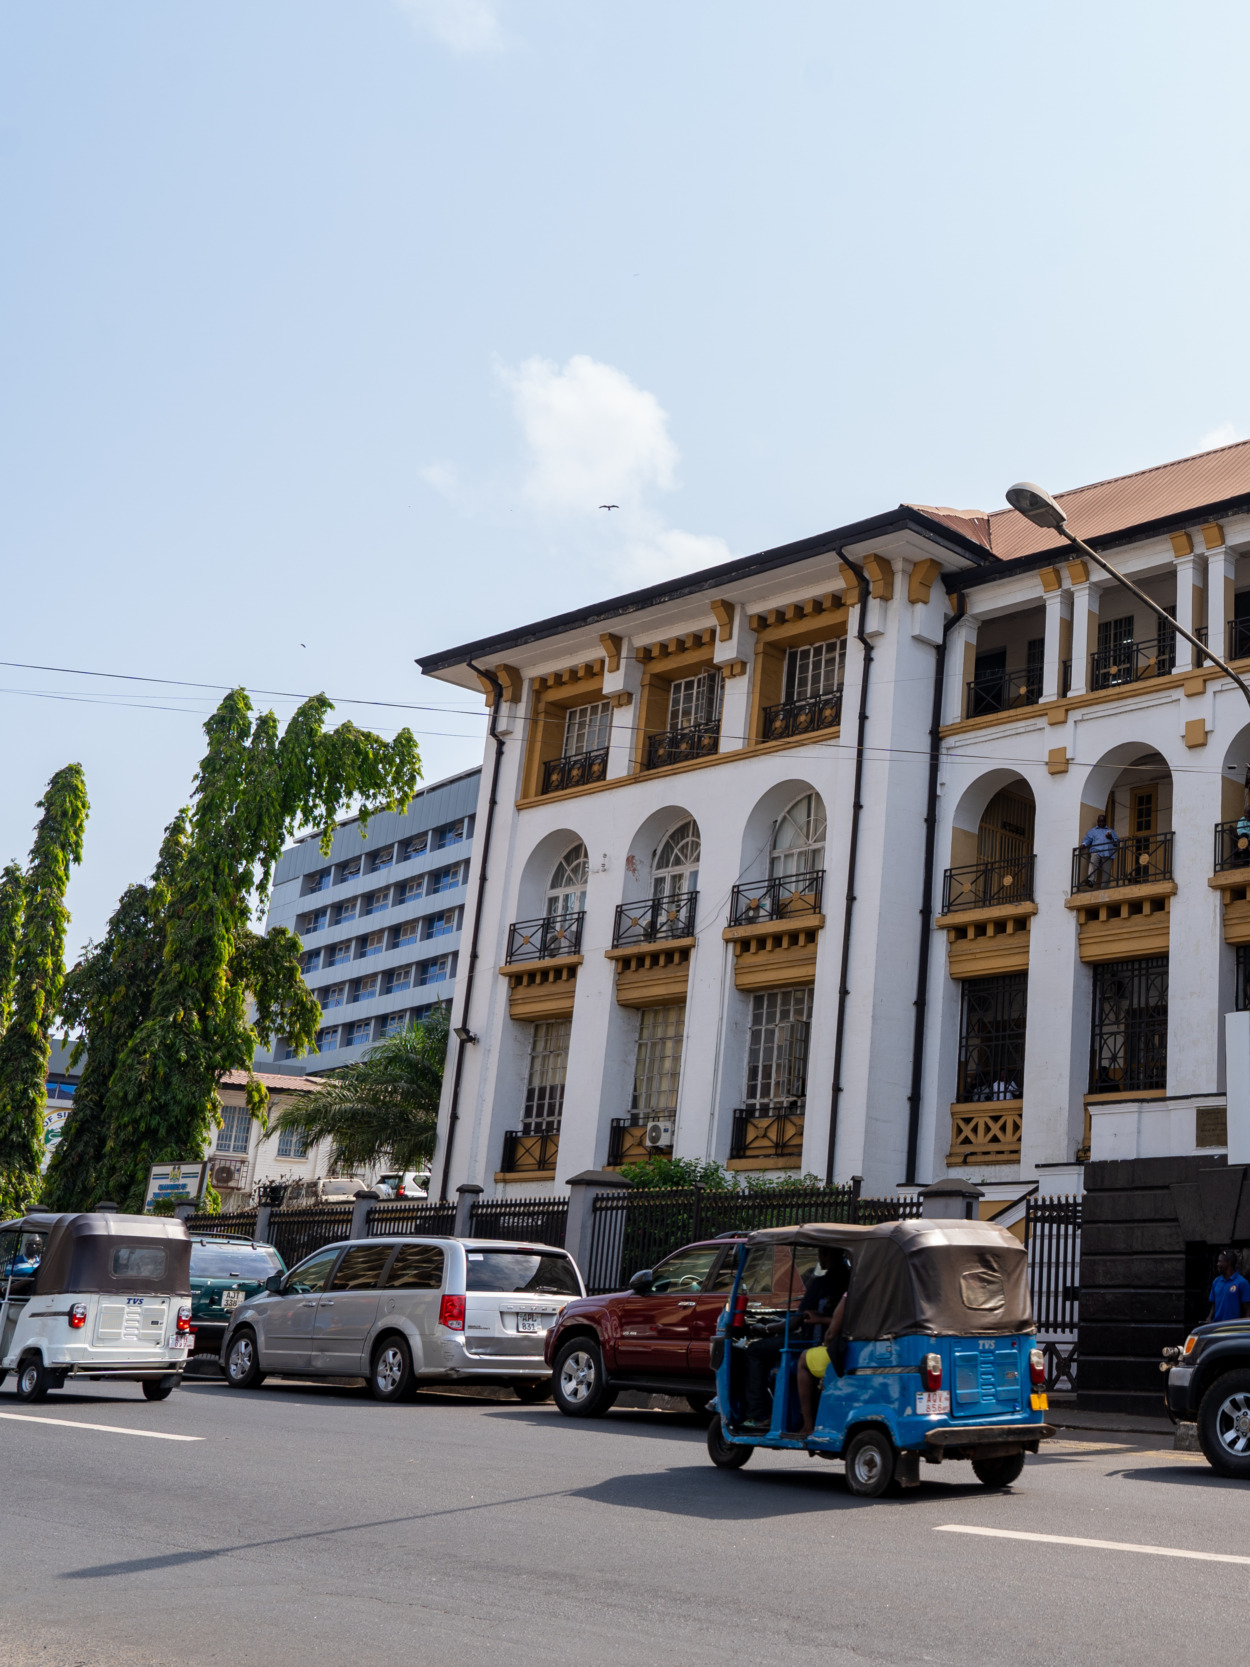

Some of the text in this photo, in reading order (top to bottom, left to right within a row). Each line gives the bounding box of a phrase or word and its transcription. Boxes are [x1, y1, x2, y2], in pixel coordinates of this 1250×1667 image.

[226, 1290, 240, 1299] AJT
[126, 1297, 144, 1305] TVS
[223, 1299, 238, 1307] 338
[521, 1322, 536, 1331] 831
[978, 1339, 996, 1350] TVS
